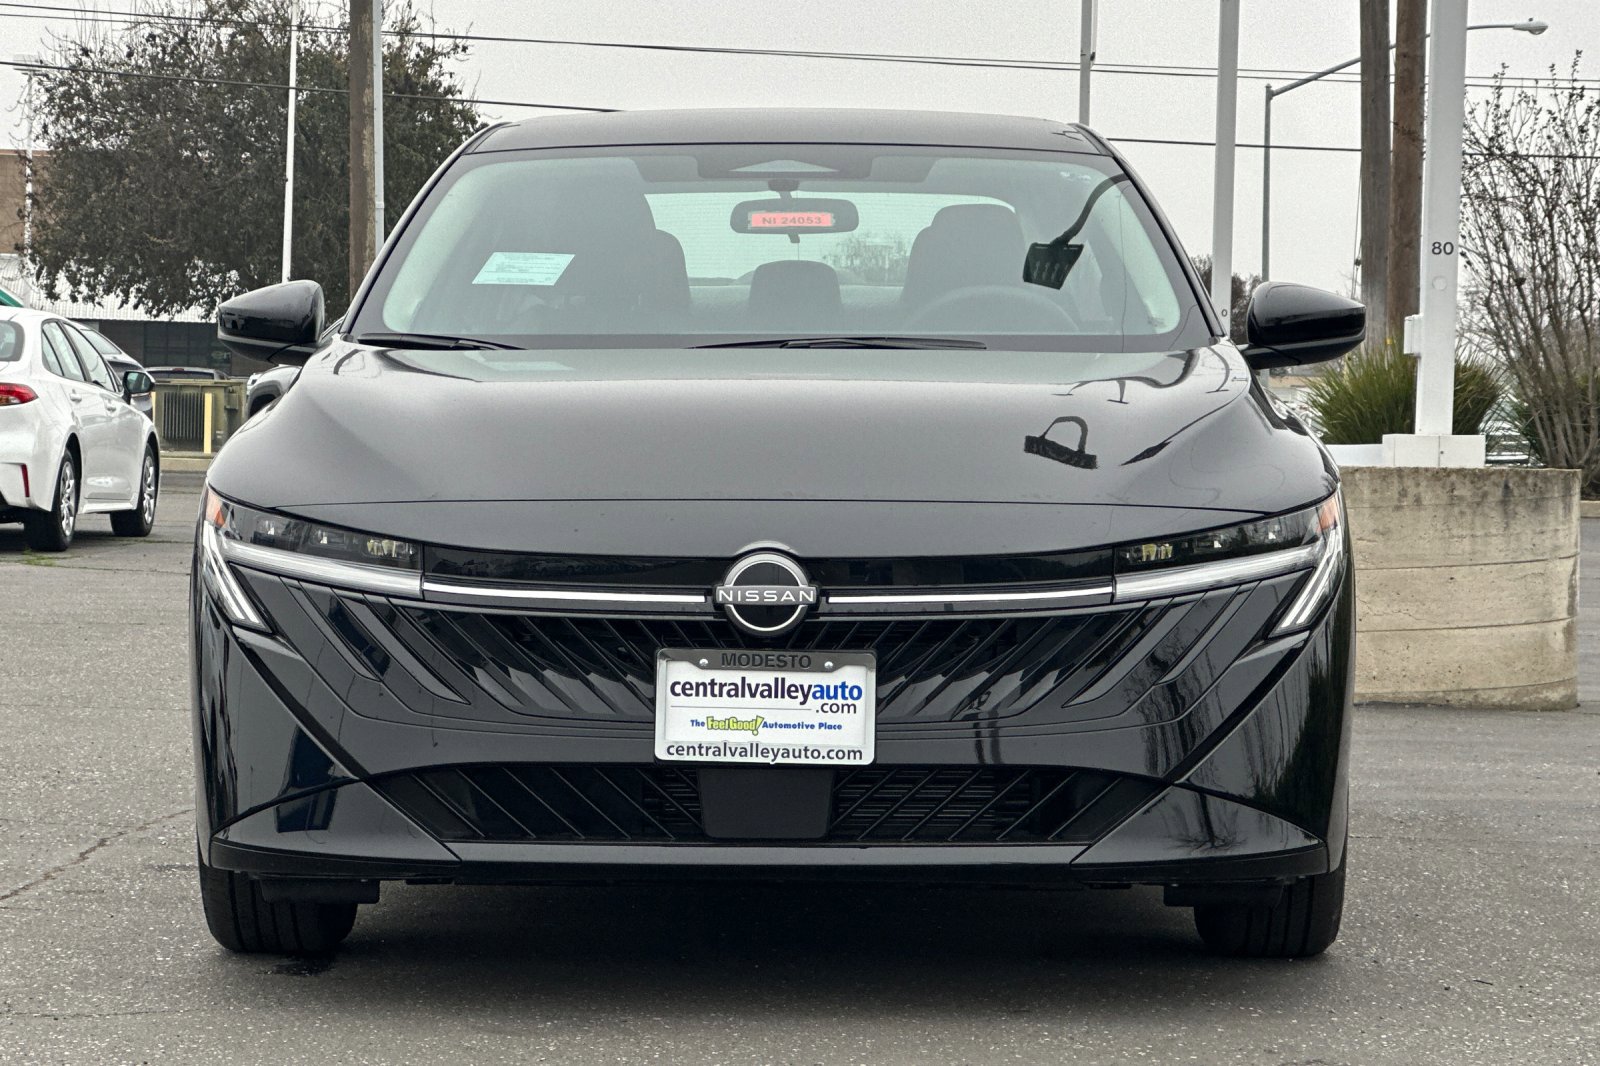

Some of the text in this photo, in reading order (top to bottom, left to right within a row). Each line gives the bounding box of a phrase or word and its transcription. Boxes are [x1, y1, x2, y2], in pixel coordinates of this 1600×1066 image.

[762, 216, 822, 225] NI 24053
[1431, 241, 1454, 255] 80
[718, 590, 814, 602] NISSAN
[721, 652, 812, 669] MODESTO
[815, 702, 857, 714] .com
[690, 719, 706, 728] The
[762, 721, 816, 730] Automotive
[818, 722, 843, 730] Place
[666, 742, 863, 762] centralvalleyauto.com
